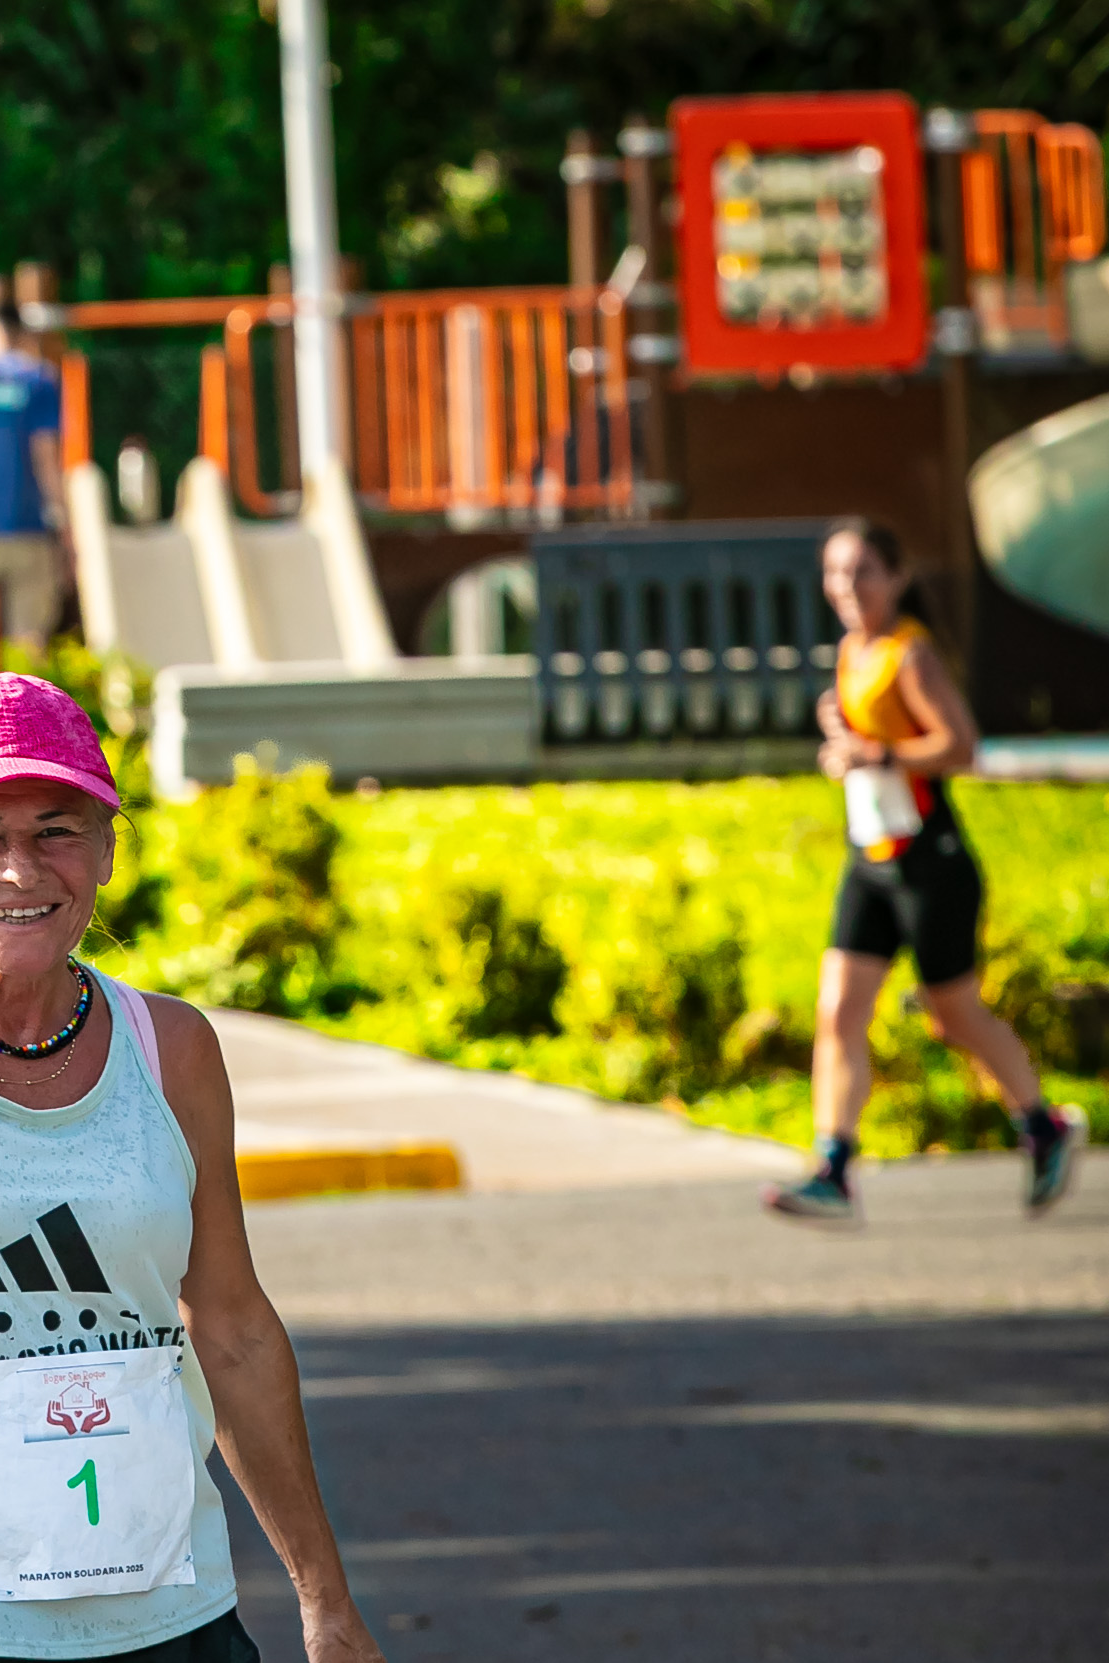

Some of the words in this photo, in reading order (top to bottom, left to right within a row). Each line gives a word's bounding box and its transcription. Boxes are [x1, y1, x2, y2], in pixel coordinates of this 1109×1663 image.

[82, 1370, 106, 1380] Roque
[67, 1459, 100, 1526] 1
[19, 1571, 72, 1582] MARATON
[74, 1566, 124, 1578] SOLIDARIA
[125, 1564, 144, 1573] 2025
